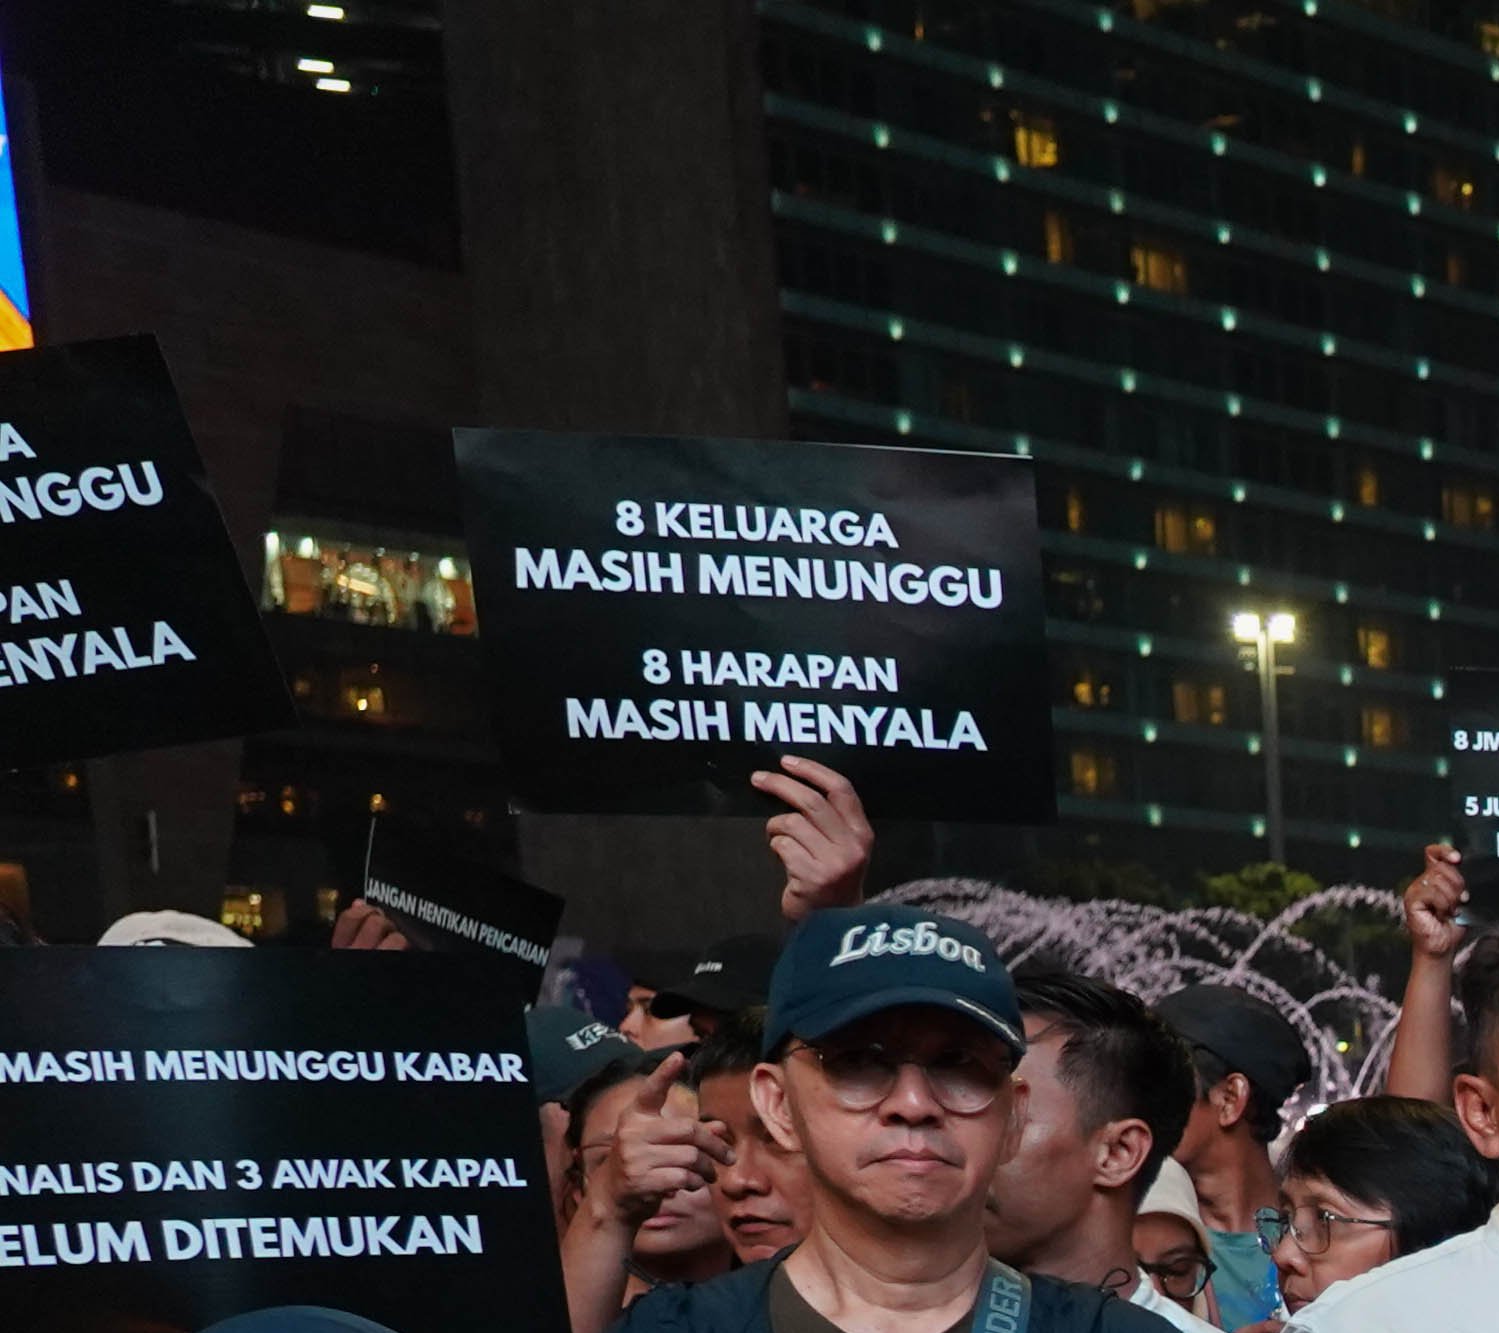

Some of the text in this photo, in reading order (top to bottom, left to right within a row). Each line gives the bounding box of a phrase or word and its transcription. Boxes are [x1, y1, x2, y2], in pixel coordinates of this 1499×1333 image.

[616, 500, 900, 548] 8 KELUARGA
[514, 547, 1003, 609] MASIH MENUNGGU
[642, 648, 899, 692] 8 HARAPAN
[565, 697, 988, 751] MASIH MENYALA
[1454, 730, 1469, 751] 8
[1465, 796, 1479, 817] 5
[366, 877, 550, 968] JANGAN HENTIKAN PENCARIAN
[829, 921, 986, 973] Lisboa
[0, 1050, 529, 1084] MASIH MENUNGGU KABAR
[133, 1160, 226, 1192] DAN
[236, 1162, 262, 1191] 3
[272, 1158, 396, 1189] AWAK
[404, 1158, 528, 1188] KAPAL
[161, 1215, 484, 1262] DITEMUKAN
